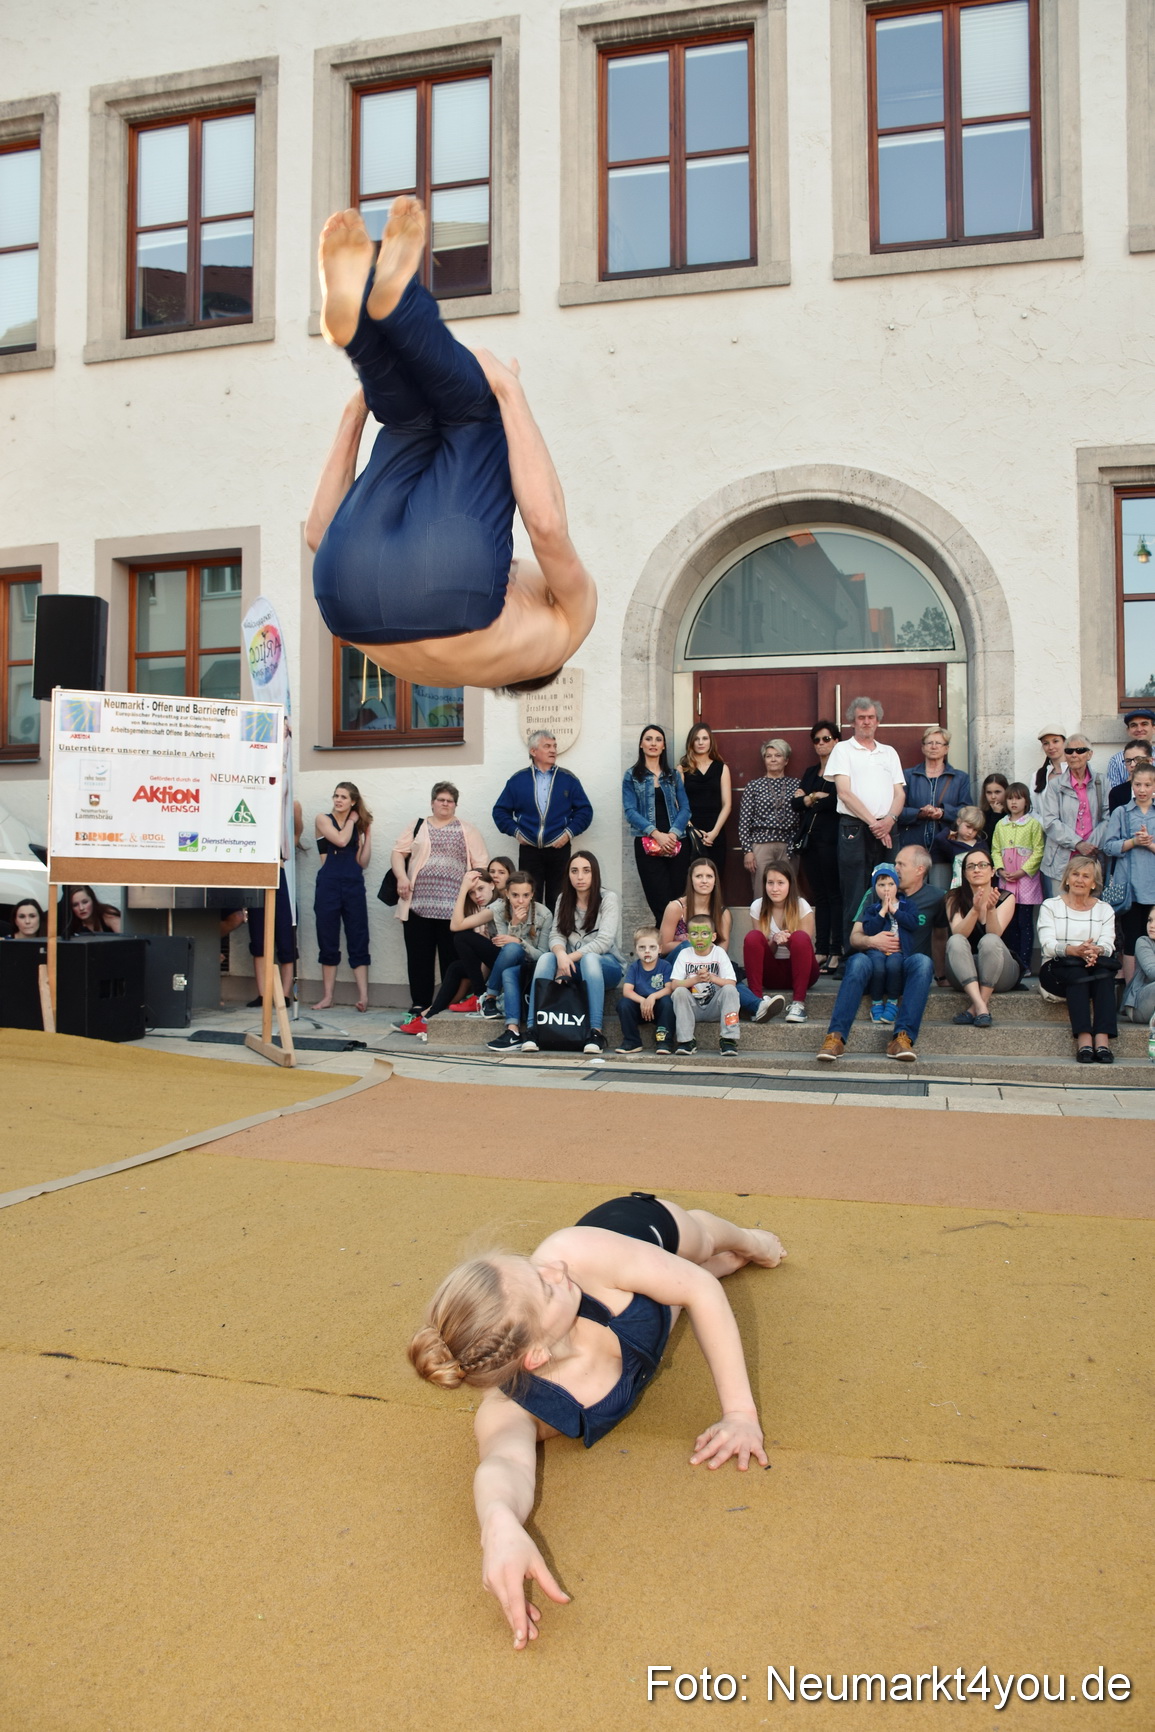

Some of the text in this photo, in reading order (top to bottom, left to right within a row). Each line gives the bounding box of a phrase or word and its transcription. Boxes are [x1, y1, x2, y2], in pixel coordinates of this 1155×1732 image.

[104, 698, 145, 710] Neumarkt
[152, 701, 173, 712] Offen
[176, 704, 190, 713] und
[193, 704, 238, 717] Barrierefrei
[111, 726, 165, 735] Arbeitsgemeinschaft
[185, 730, 230, 739] Behindertenarbeit
[59, 744, 114, 753] Unterstützer
[153, 749, 187, 757] sozialen
[190, 750, 215, 758] Arbeit
[210, 773, 266, 784] NEUMARKT
[161, 804, 200, 813] MENSCH
[75, 812, 113, 820] Lammsbräu
[202, 837, 256, 847] Dienstleistungen
[536, 1010, 586, 1026] ONLY
